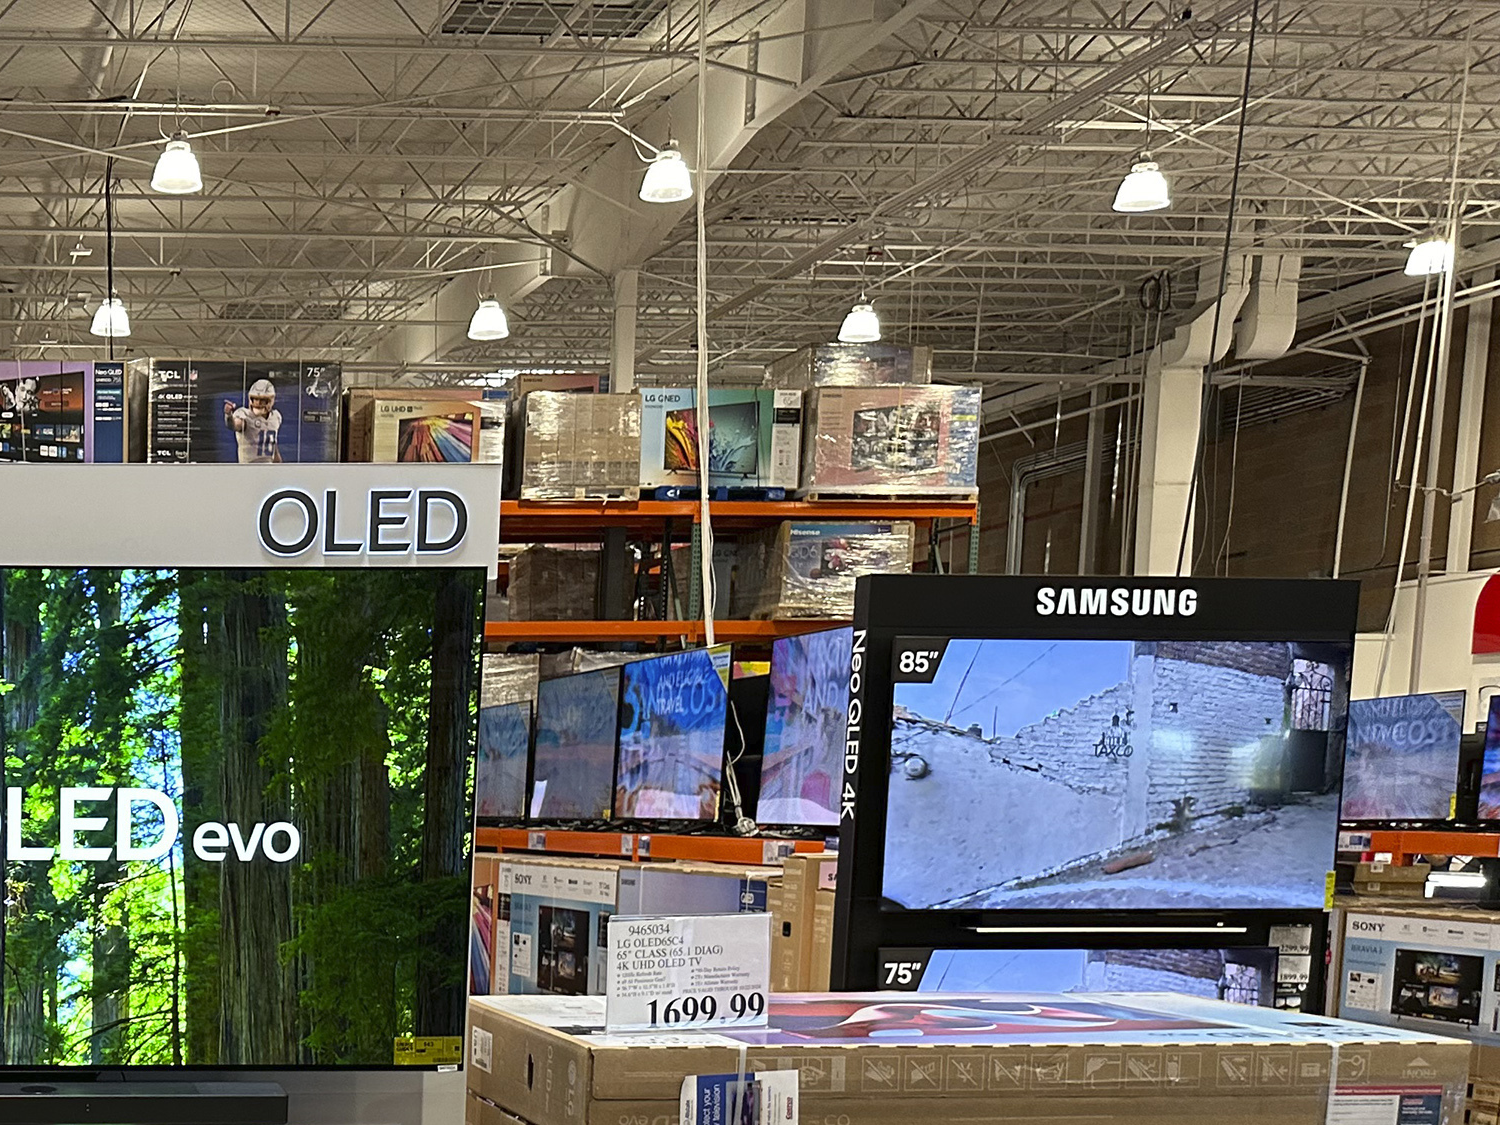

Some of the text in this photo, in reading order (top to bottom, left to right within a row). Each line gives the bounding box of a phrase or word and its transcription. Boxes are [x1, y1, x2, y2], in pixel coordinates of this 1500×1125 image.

[158, 370, 180, 379] TCL
[644, 394, 656, 402] LG
[380, 404, 390, 412] LG
[257, 487, 469, 556] OLED
[790, 528, 820, 536] Hisense
[1036, 587, 1198, 616] SAMSUNG
[899, 650, 939, 673] 85"
[656, 697, 685, 715] TRAVEL
[841, 629, 867, 820] Neo QLED 4K
[192, 820, 302, 864] evo
[514, 873, 532, 884] SONY
[628, 924, 670, 936] 9465034
[1352, 920, 1386, 932] SONY
[616, 936, 684, 948] LG OLED65C4
[616, 945, 724, 960] 65" CLASS (65.1 DIAG)
[616, 957, 702, 970] 4K UHD OLED TV
[884, 962, 922, 985] 75"
[646, 992, 765, 1028] 1699.99
[1402, 1068, 1437, 1079] FRONT
[703, 1088, 712, 1108] your
[712, 1084, 720, 1122] television
